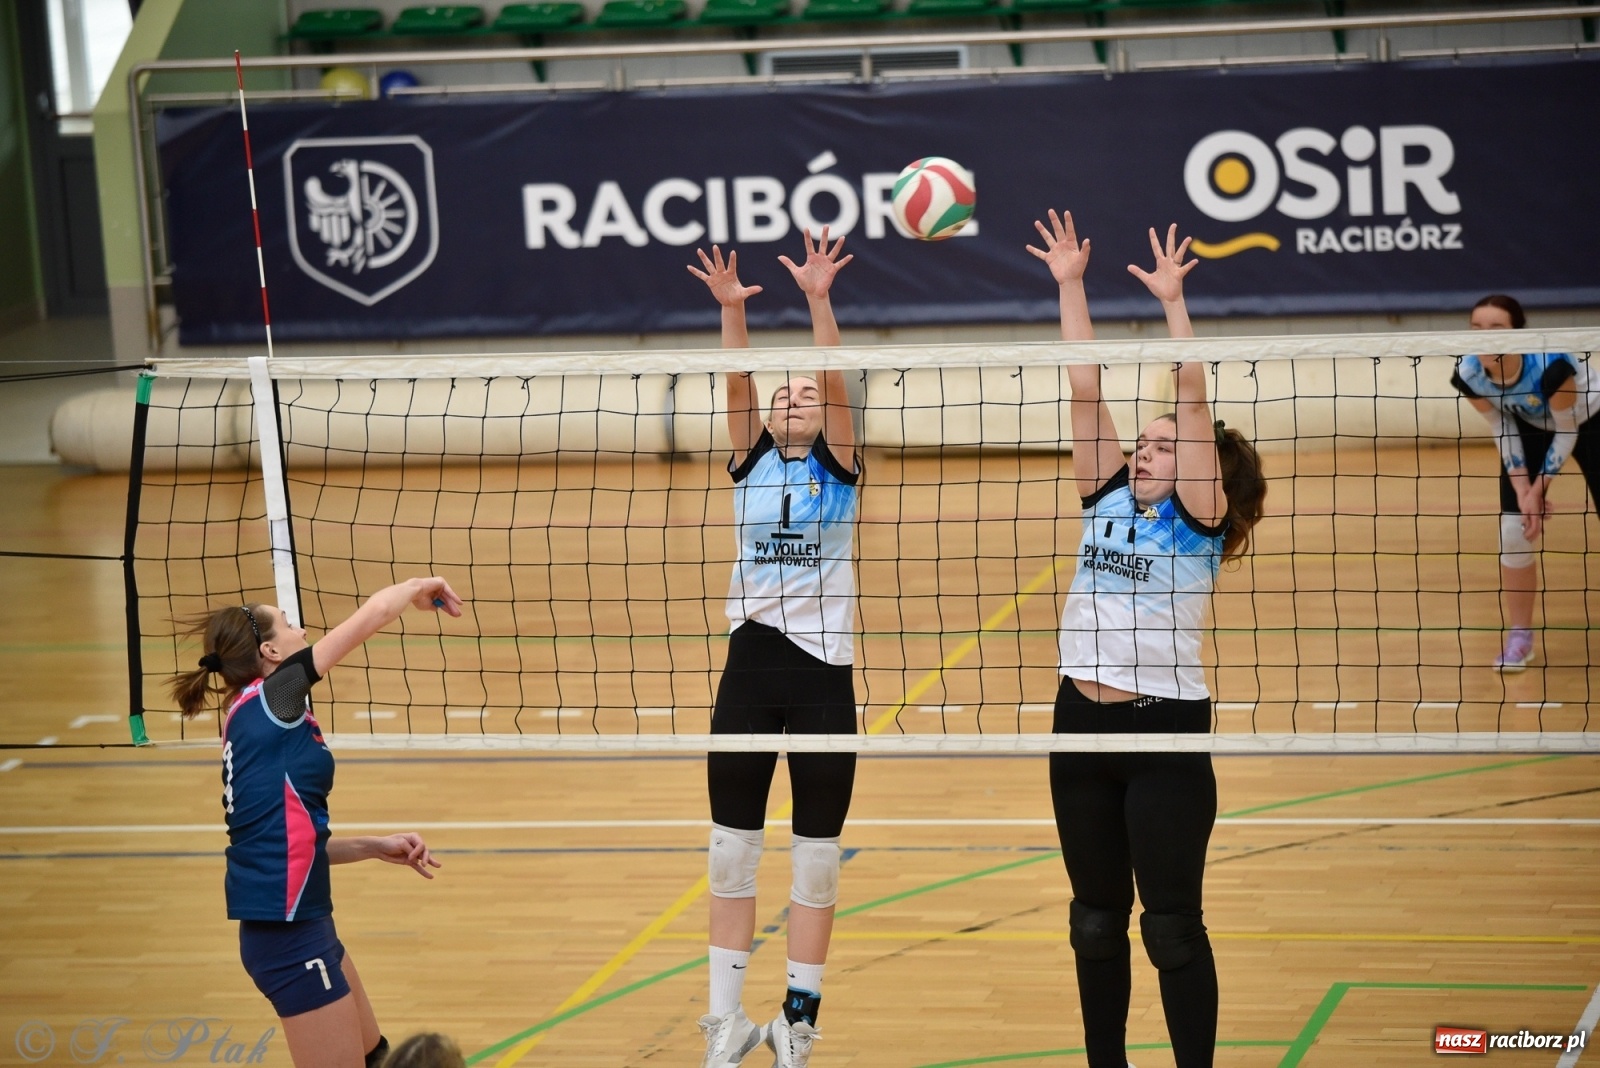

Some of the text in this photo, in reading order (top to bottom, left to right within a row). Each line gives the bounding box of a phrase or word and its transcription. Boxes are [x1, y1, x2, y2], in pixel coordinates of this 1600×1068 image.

[522, 150, 979, 249] RACIBÓR
[1296, 217, 1463, 254] RACIBÓRZ
[754, 556, 819, 567] KRAPKOWICE
[755, 541, 820, 556] PV VOLLEY
[1084, 545, 1154, 572] PV VOLLEY
[1084, 560, 1150, 582] KRAPKOWICE
[305, 958, 332, 990] 7
